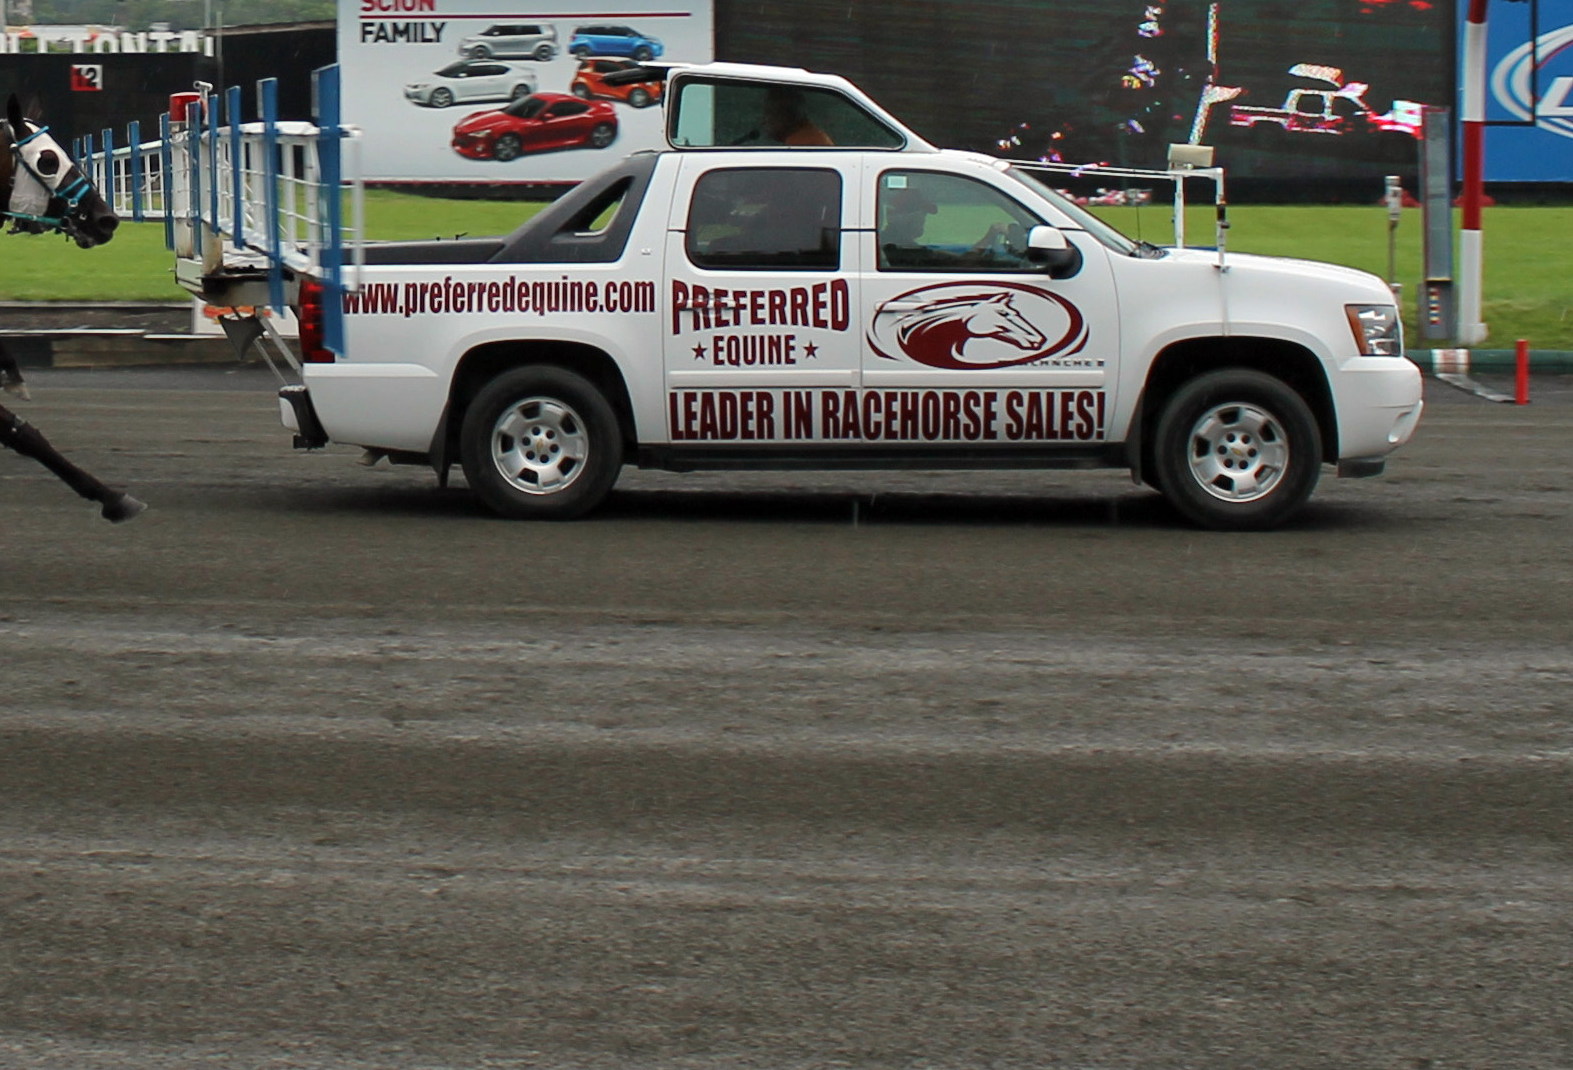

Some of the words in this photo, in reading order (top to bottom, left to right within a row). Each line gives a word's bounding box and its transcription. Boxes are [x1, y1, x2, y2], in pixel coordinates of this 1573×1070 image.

[360, 22, 447, 44] FAMILY
[75, 67, 98, 87] 12
[341, 275, 655, 318] www.preferredequine.com
[672, 278, 850, 336] PREFERRED
[713, 334, 796, 367] EQUINE
[669, 391, 775, 441] LEADER
[783, 390, 813, 440] IN
[821, 390, 998, 441] RACEHORSE
[1005, 390, 1106, 441] SALES!
